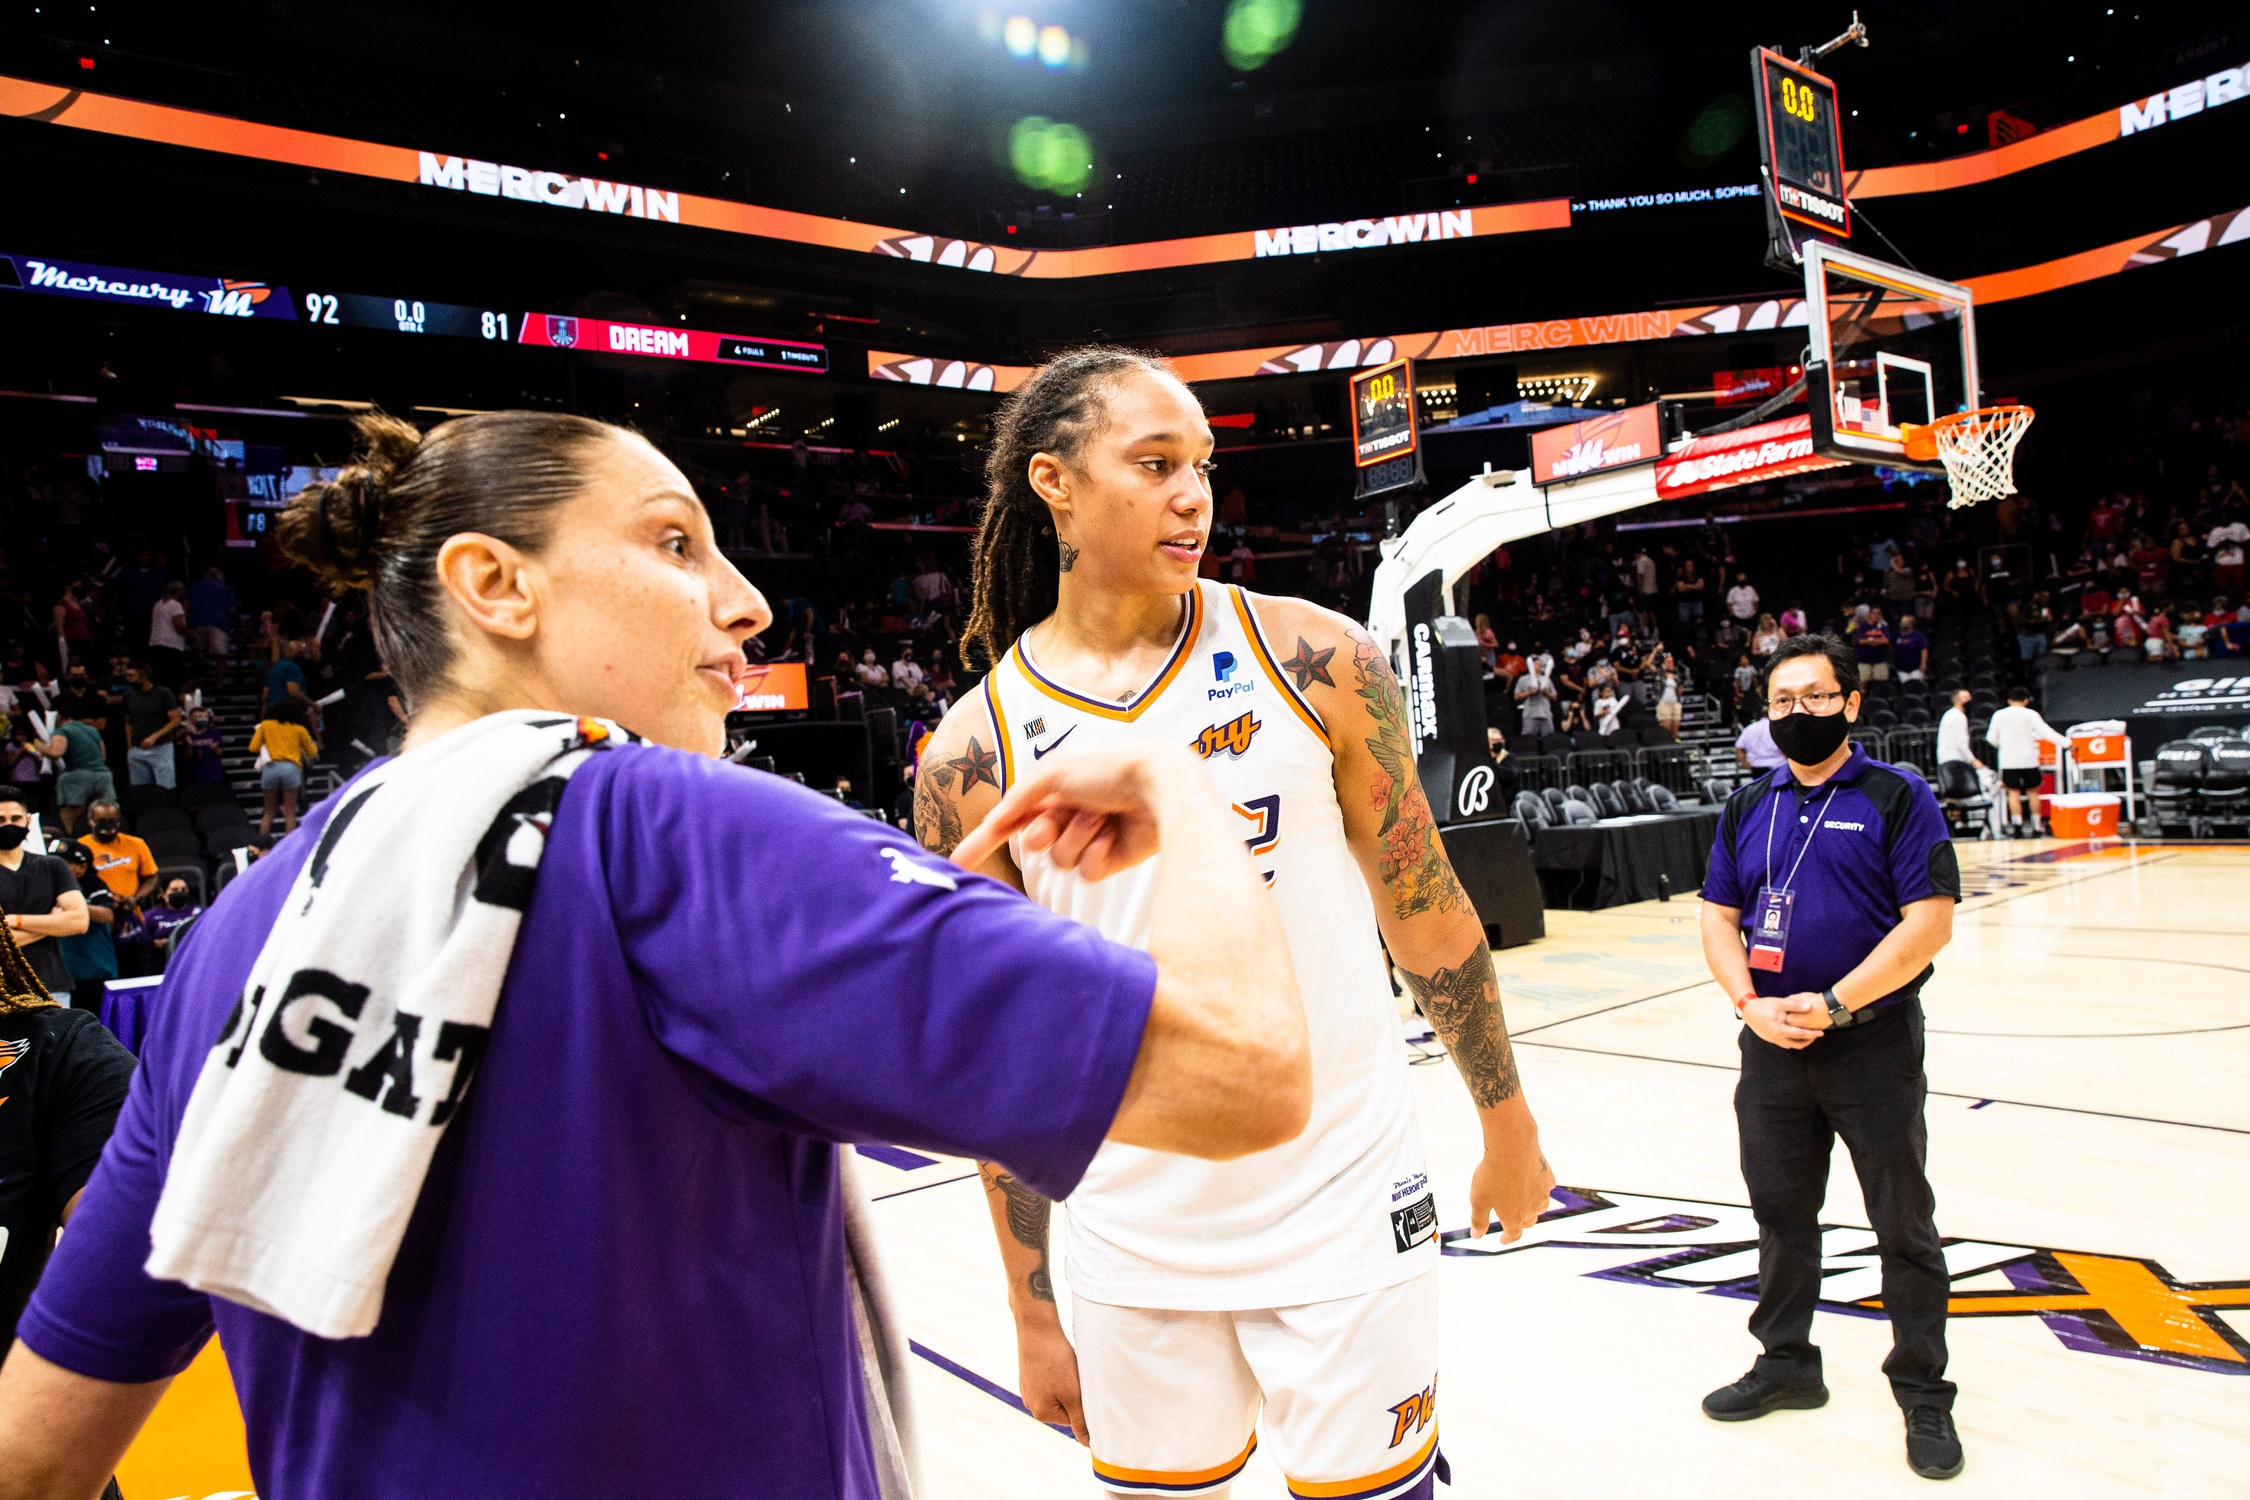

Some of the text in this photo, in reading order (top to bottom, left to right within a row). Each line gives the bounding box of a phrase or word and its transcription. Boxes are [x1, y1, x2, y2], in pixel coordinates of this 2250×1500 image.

[2119, 62, 2250, 137] MER
[419, 151, 680, 223] MERC WIN
[1588, 199, 1628, 212] THANK
[1628, 195, 1653, 207] YOU
[1655, 192, 1674, 204] SO
[1797, 191, 1845, 224] TISSOT
[1254, 209, 1473, 258] MERC WIN
[26, 260, 194, 309] Mercury
[306, 293, 340, 325] 92
[394, 299, 426, 323] 0.0
[481, 311, 508, 341] 81
[609, 325, 689, 357] DREAM
[1450, 310, 1671, 357] MERC WIN
[1372, 430, 1411, 451] TISSOT
[1603, 443, 1641, 465] WIN
[744, 694, 785, 709] WIN
[1207, 680, 1255, 701] PayPal
[2088, 738, 2106, 755] G
[1823, 820, 1865, 832] SECURITY
[2087, 809, 2102, 826] G
[1387, 1368, 1438, 1449] Ph
